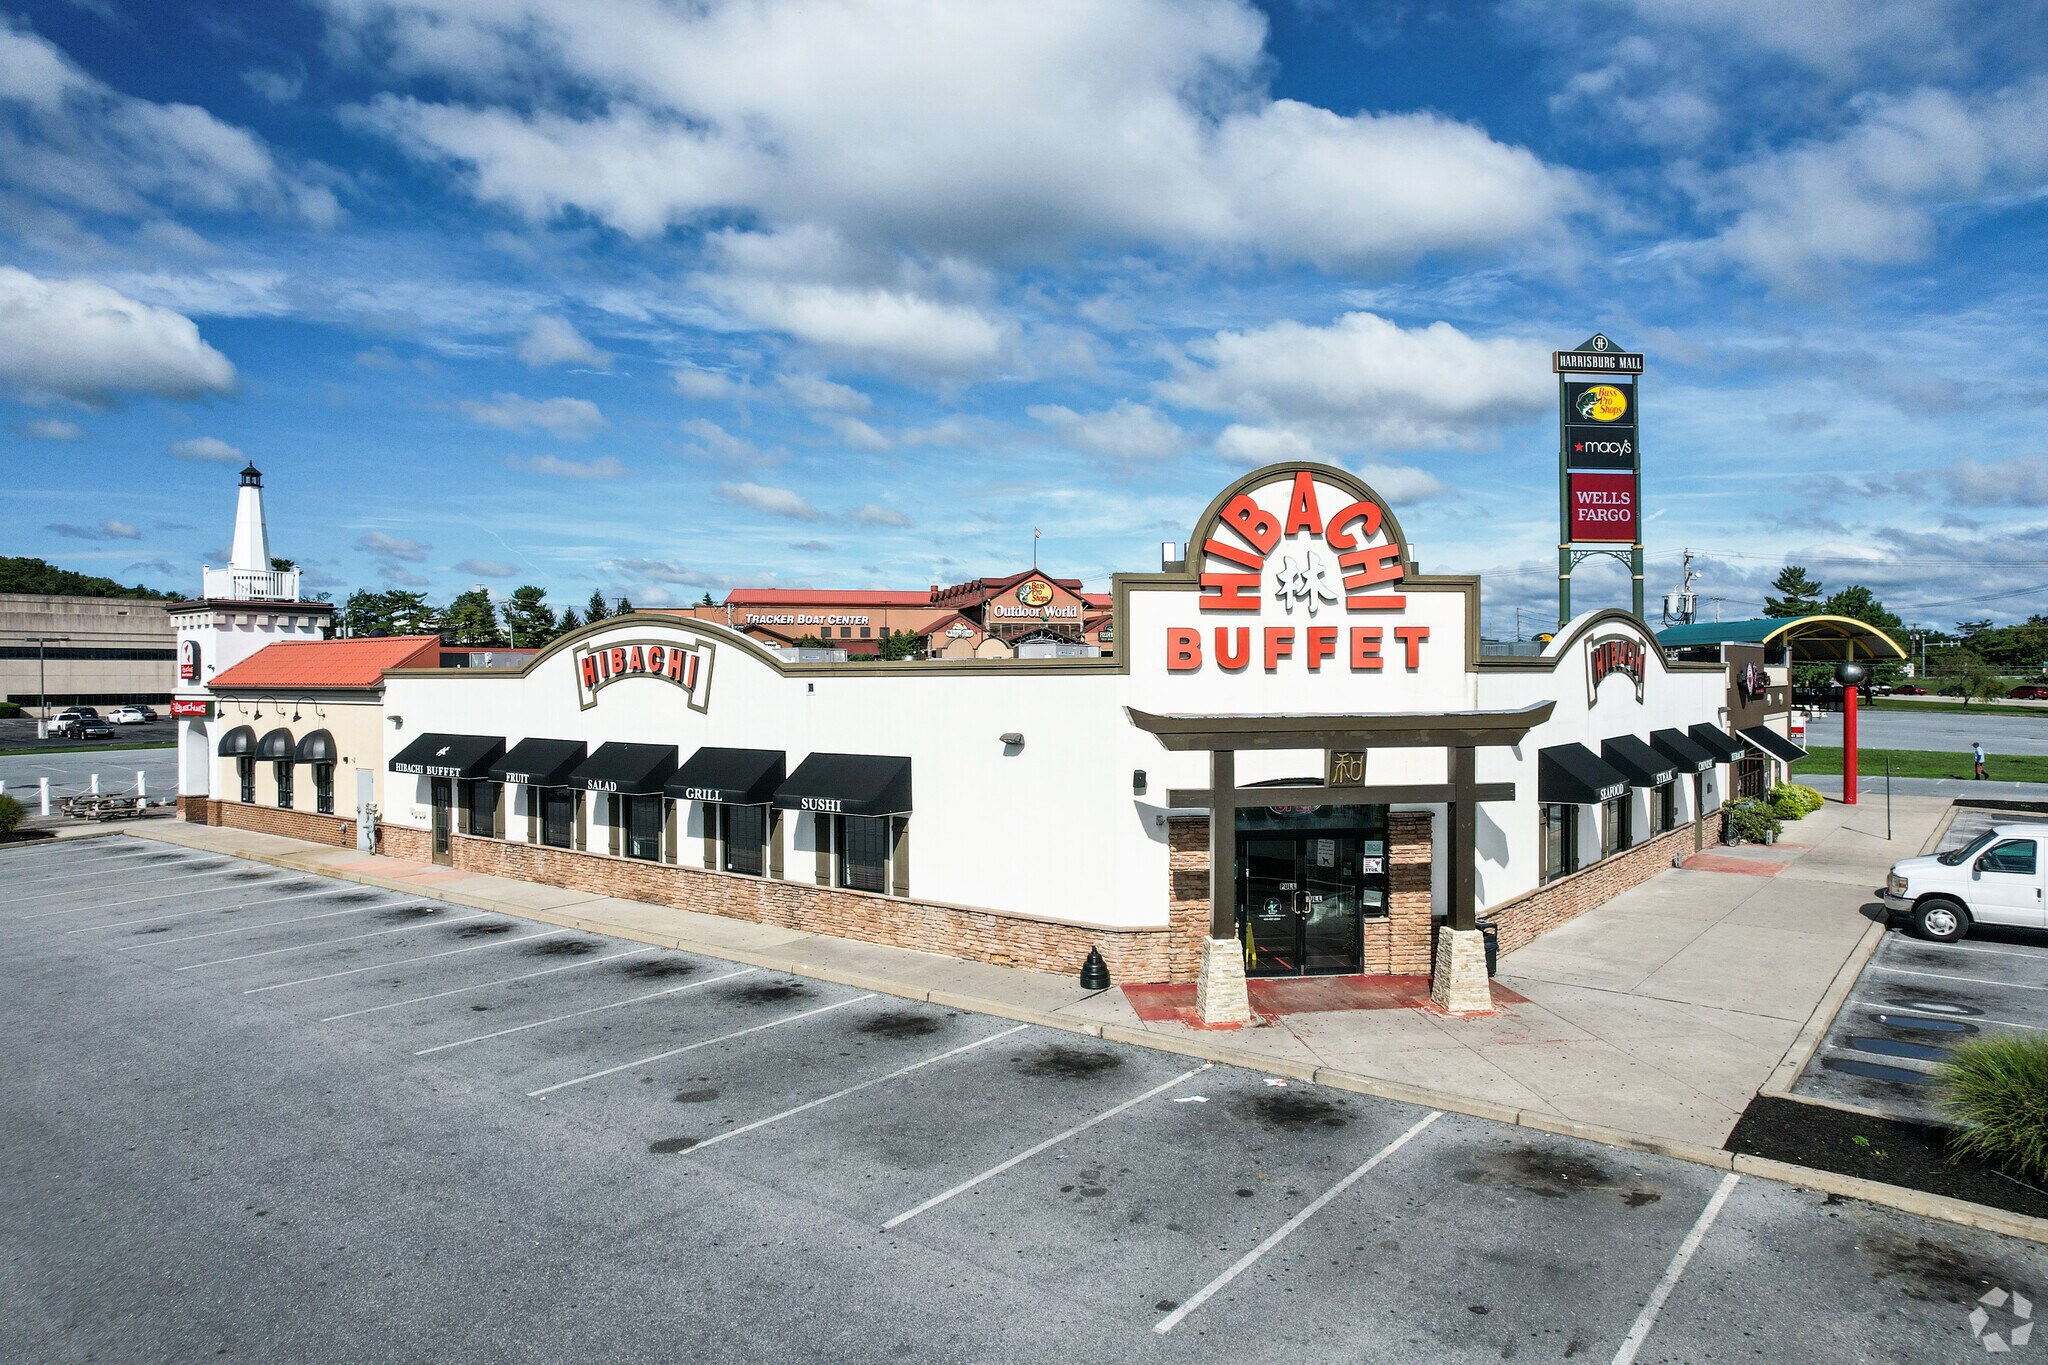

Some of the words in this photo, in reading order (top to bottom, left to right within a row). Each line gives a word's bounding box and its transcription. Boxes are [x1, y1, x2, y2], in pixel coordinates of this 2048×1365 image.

[1560, 355, 1615, 368] HARRISBURG
[1619, 356, 1642, 369] MALL
[1599, 387, 1617, 397] Bass
[1599, 397, 1613, 405] Pro
[1600, 405, 1622, 416] Shops
[1585, 440, 1632, 457] macy's
[1576, 491, 1631, 505] WELLS
[1578, 508, 1631, 522] FARGO
[1199, 471, 1406, 610] HIBACHI
[1031, 582, 1045, 590] Bass
[1032, 594, 1049, 603] Shops
[994, 605, 1041, 618] Outdoor
[1044, 605, 1077, 618] World
[1167, 626, 1430, 670] BUFFET
[581, 646, 700, 688] HIBACHI
[395, 762, 424, 774] HIBACHI
[426, 765, 461, 777] BUFFET
[1697, 759, 1713, 772] CHINESE
[505, 772, 529, 784] FRUIT
[1656, 770, 1673, 784] STEAK
[587, 779, 617, 792] SALAD
[1600, 783, 1624, 800] SEAFOOD
[685, 787, 723, 802] GRILL
[801, 797, 842, 812] SUSHI
